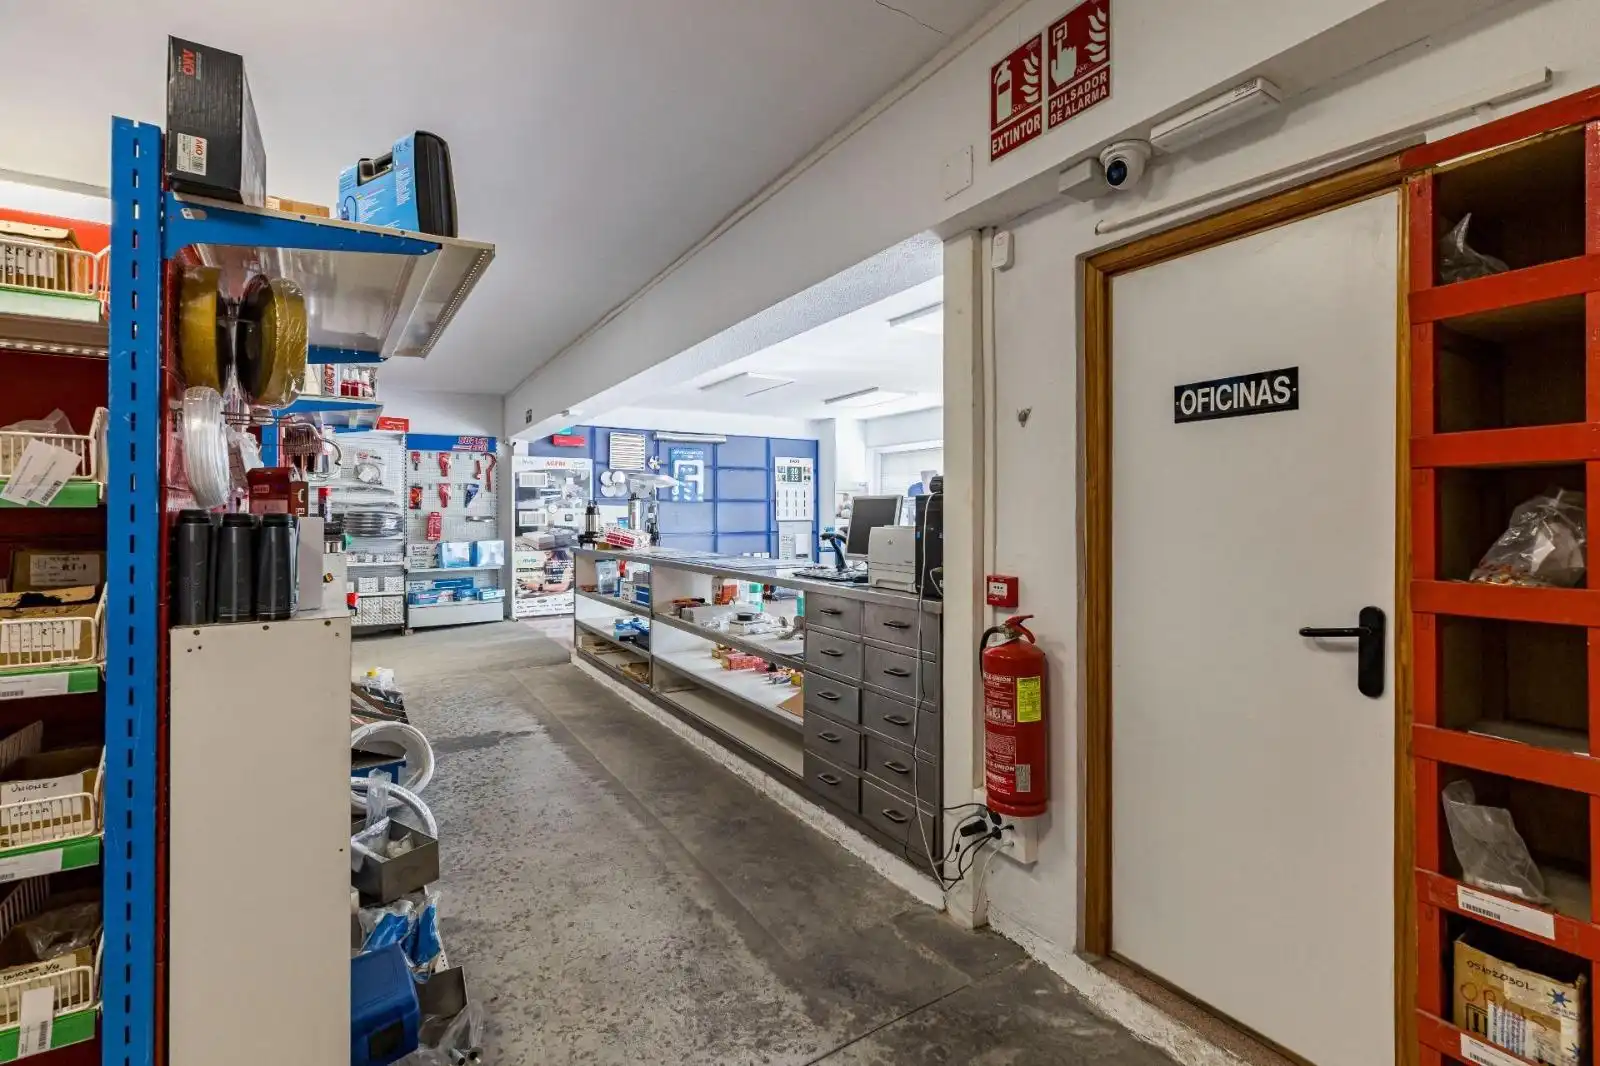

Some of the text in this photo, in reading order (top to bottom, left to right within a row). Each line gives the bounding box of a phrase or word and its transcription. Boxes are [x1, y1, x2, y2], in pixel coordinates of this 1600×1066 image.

[183, 48, 196, 77] AKO
[1050, 71, 1107, 112] PULSADOR
[1050, 86, 1107, 126] DE ALARMA
[195, 137, 204, 156] AKO
[992, 113, 1041, 155] EXTINTOR
[1180, 375, 1292, 415] OFICINAS
